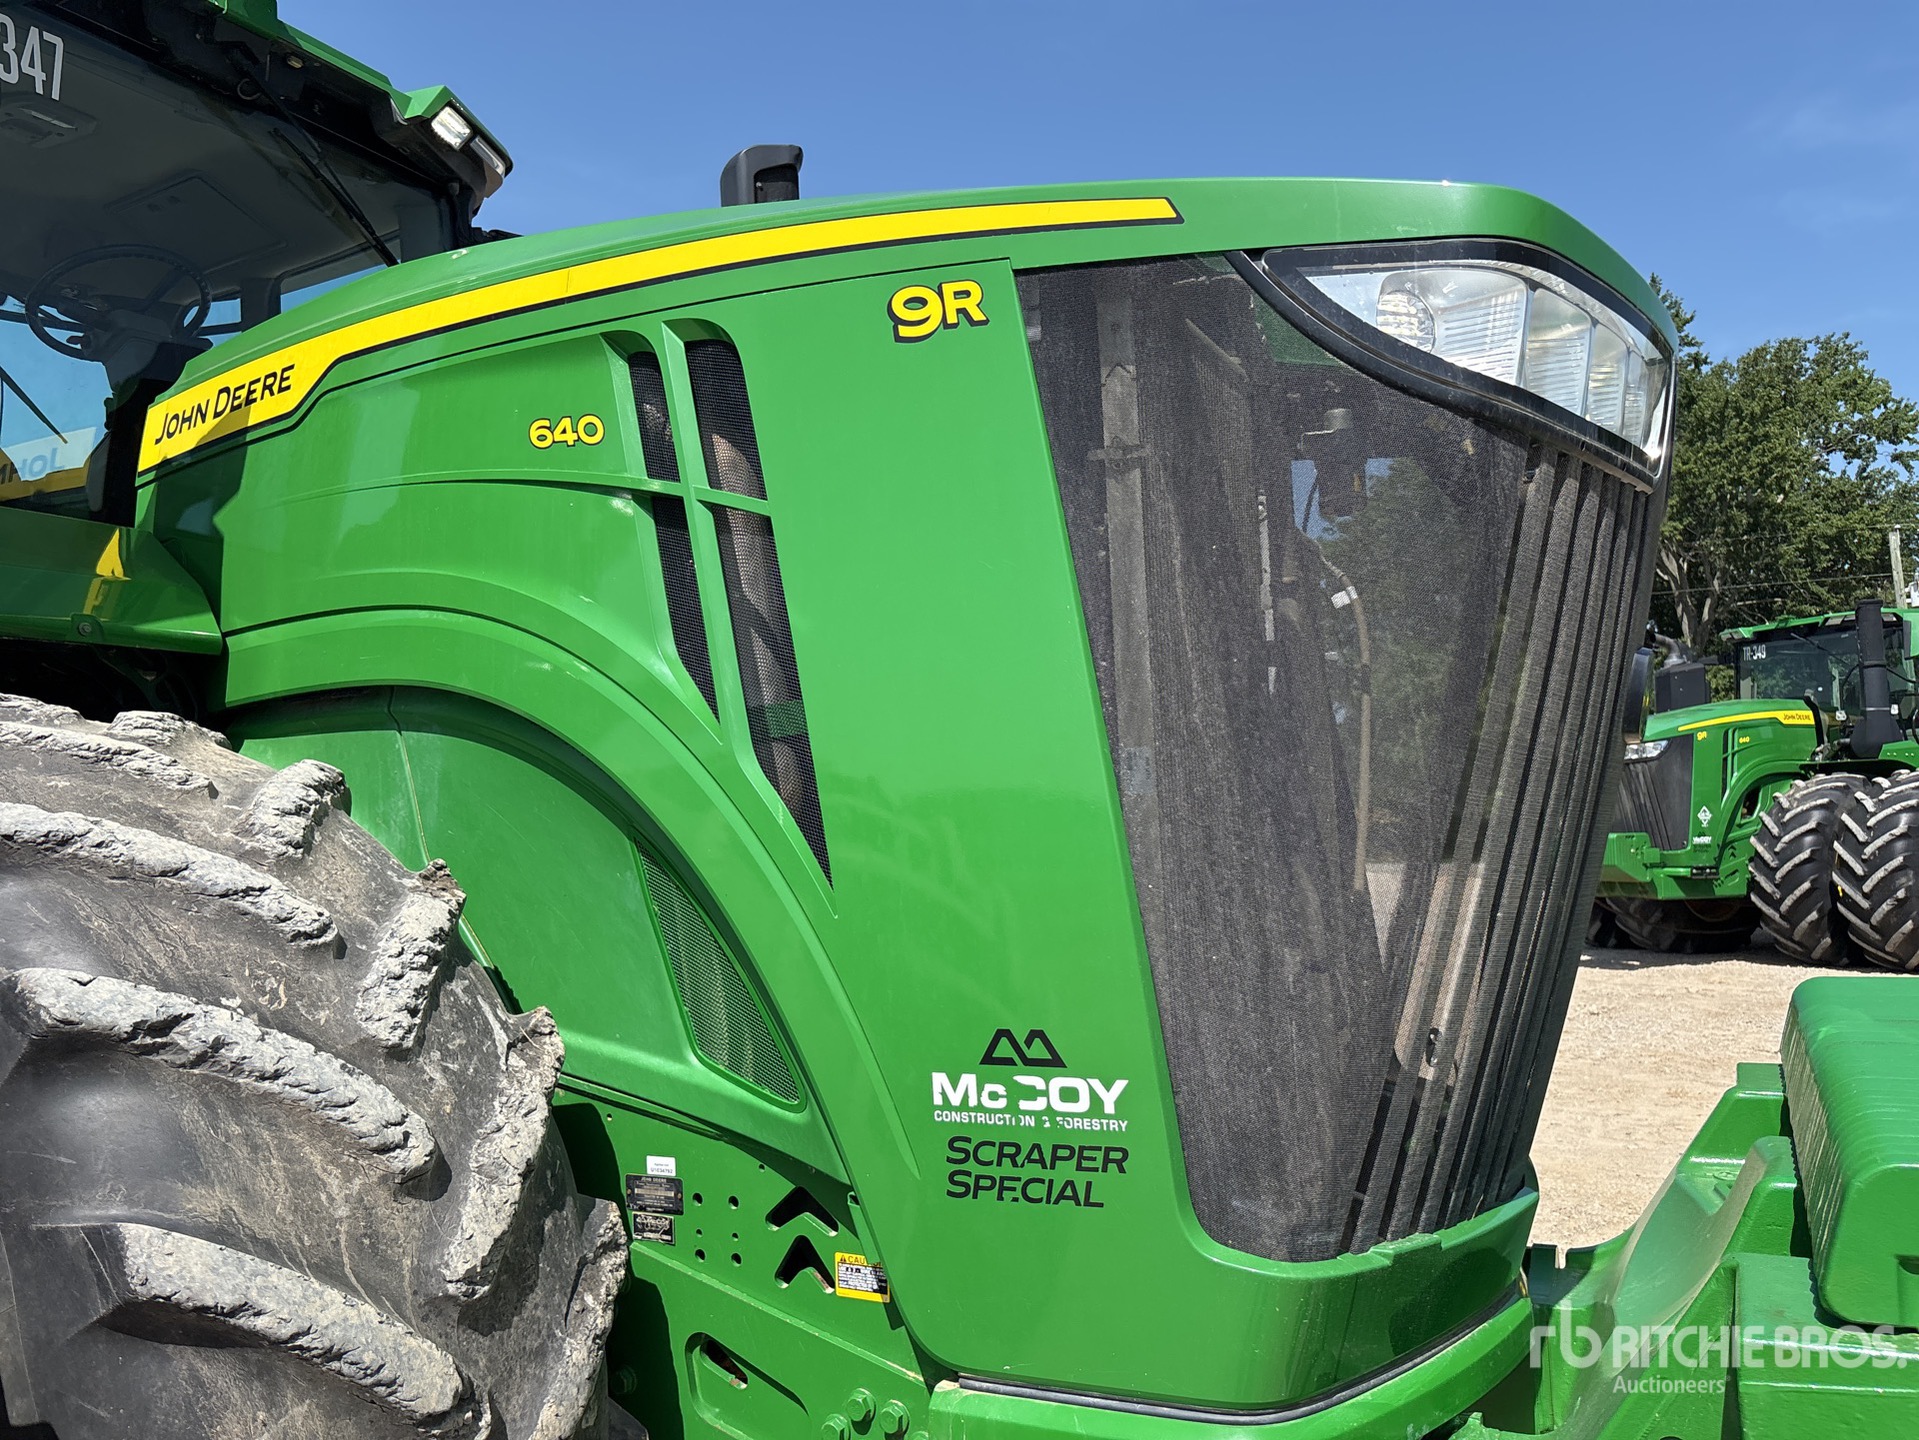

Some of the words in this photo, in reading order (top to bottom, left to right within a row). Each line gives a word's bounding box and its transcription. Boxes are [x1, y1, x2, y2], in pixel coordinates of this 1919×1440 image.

[0, 13, 64, 101] 347
[886, 279, 990, 344] 9R
[154, 398, 210, 446] JOHN
[212, 363, 295, 420] DEERE
[528, 413, 605, 449] 640
[1743, 644, 1766, 661] TR-349
[946, 1136, 1130, 1174] SCRAPER
[946, 1169, 1104, 1208] SPECIAL
